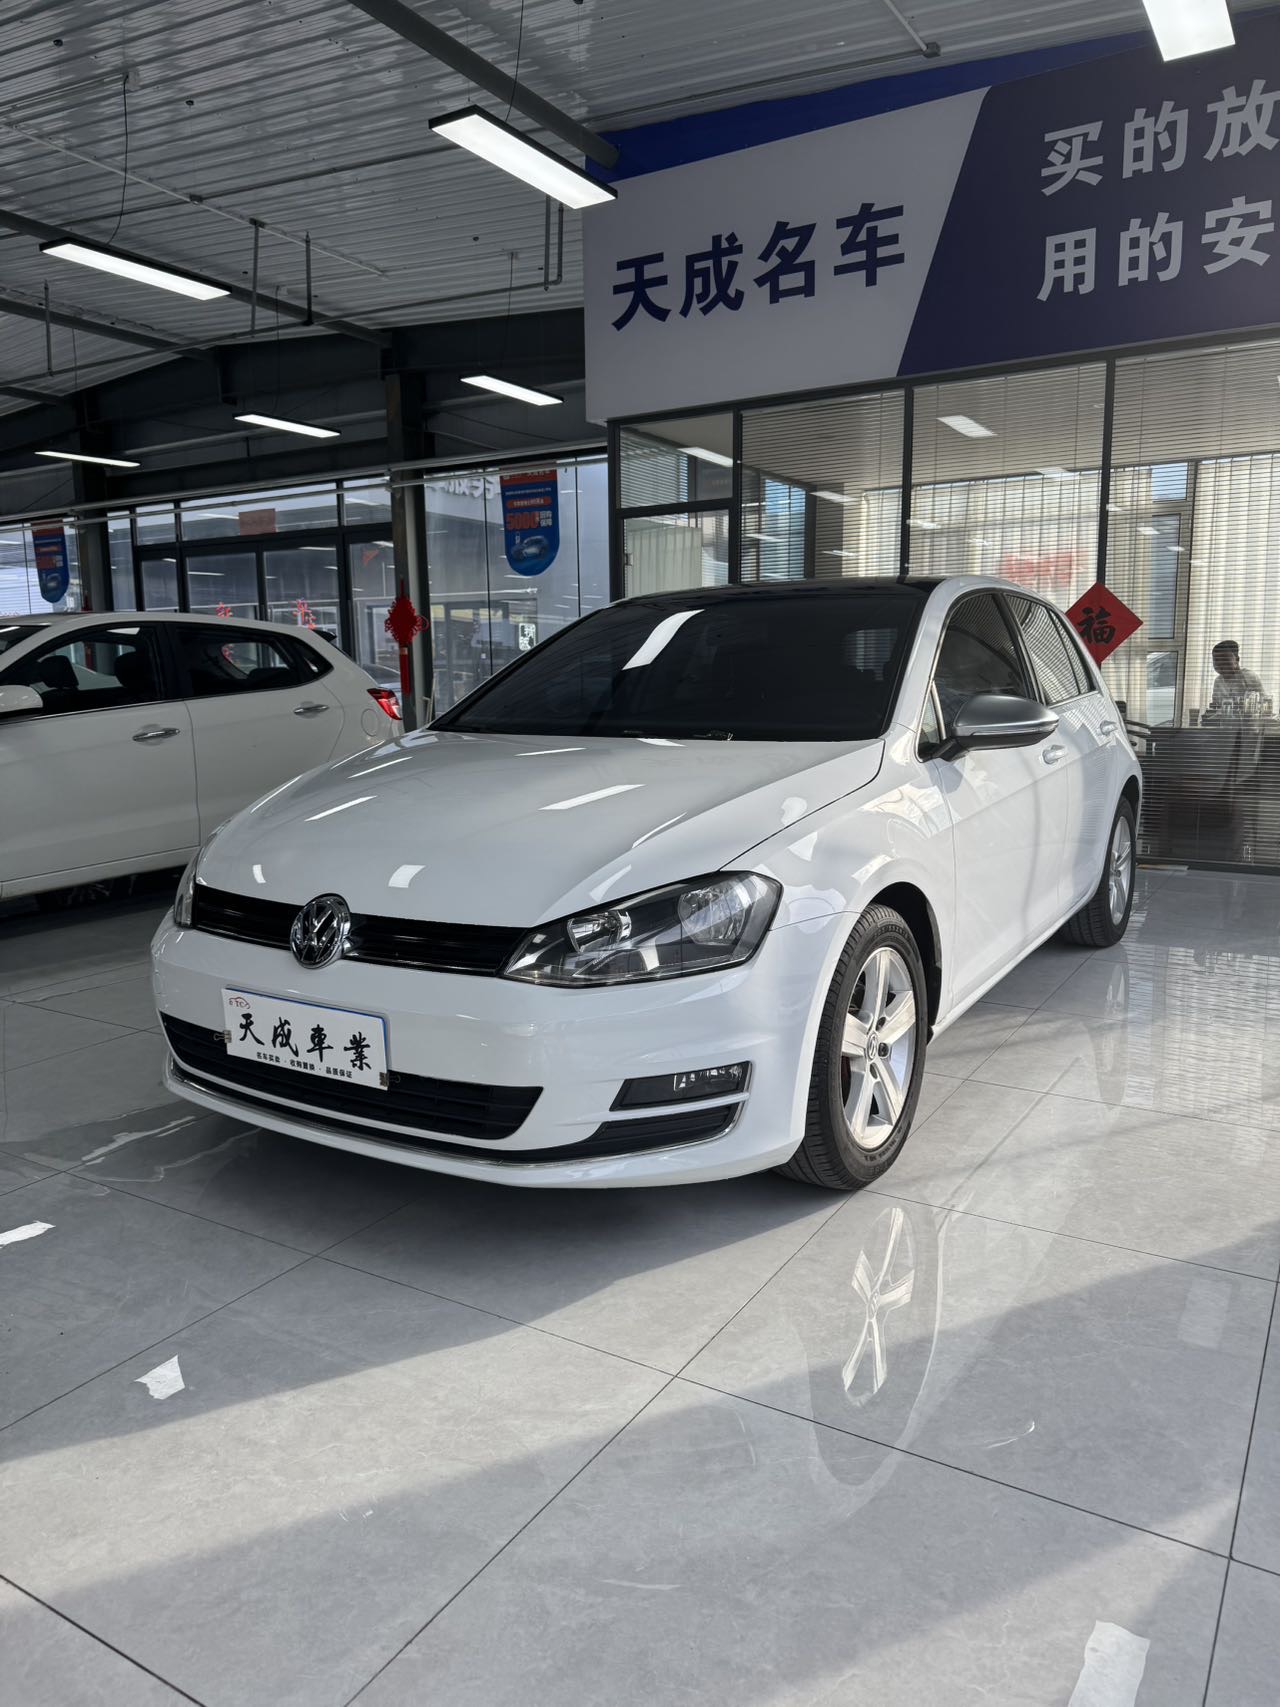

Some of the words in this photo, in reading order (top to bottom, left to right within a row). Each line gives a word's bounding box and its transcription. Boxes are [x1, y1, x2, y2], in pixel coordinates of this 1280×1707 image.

[1041, 79, 1280, 196] 买的放
[611, 202, 905, 331] 天成名车
[1036, 195, 1275, 302] 用的安
[1077, 606, 1116, 644] 福
